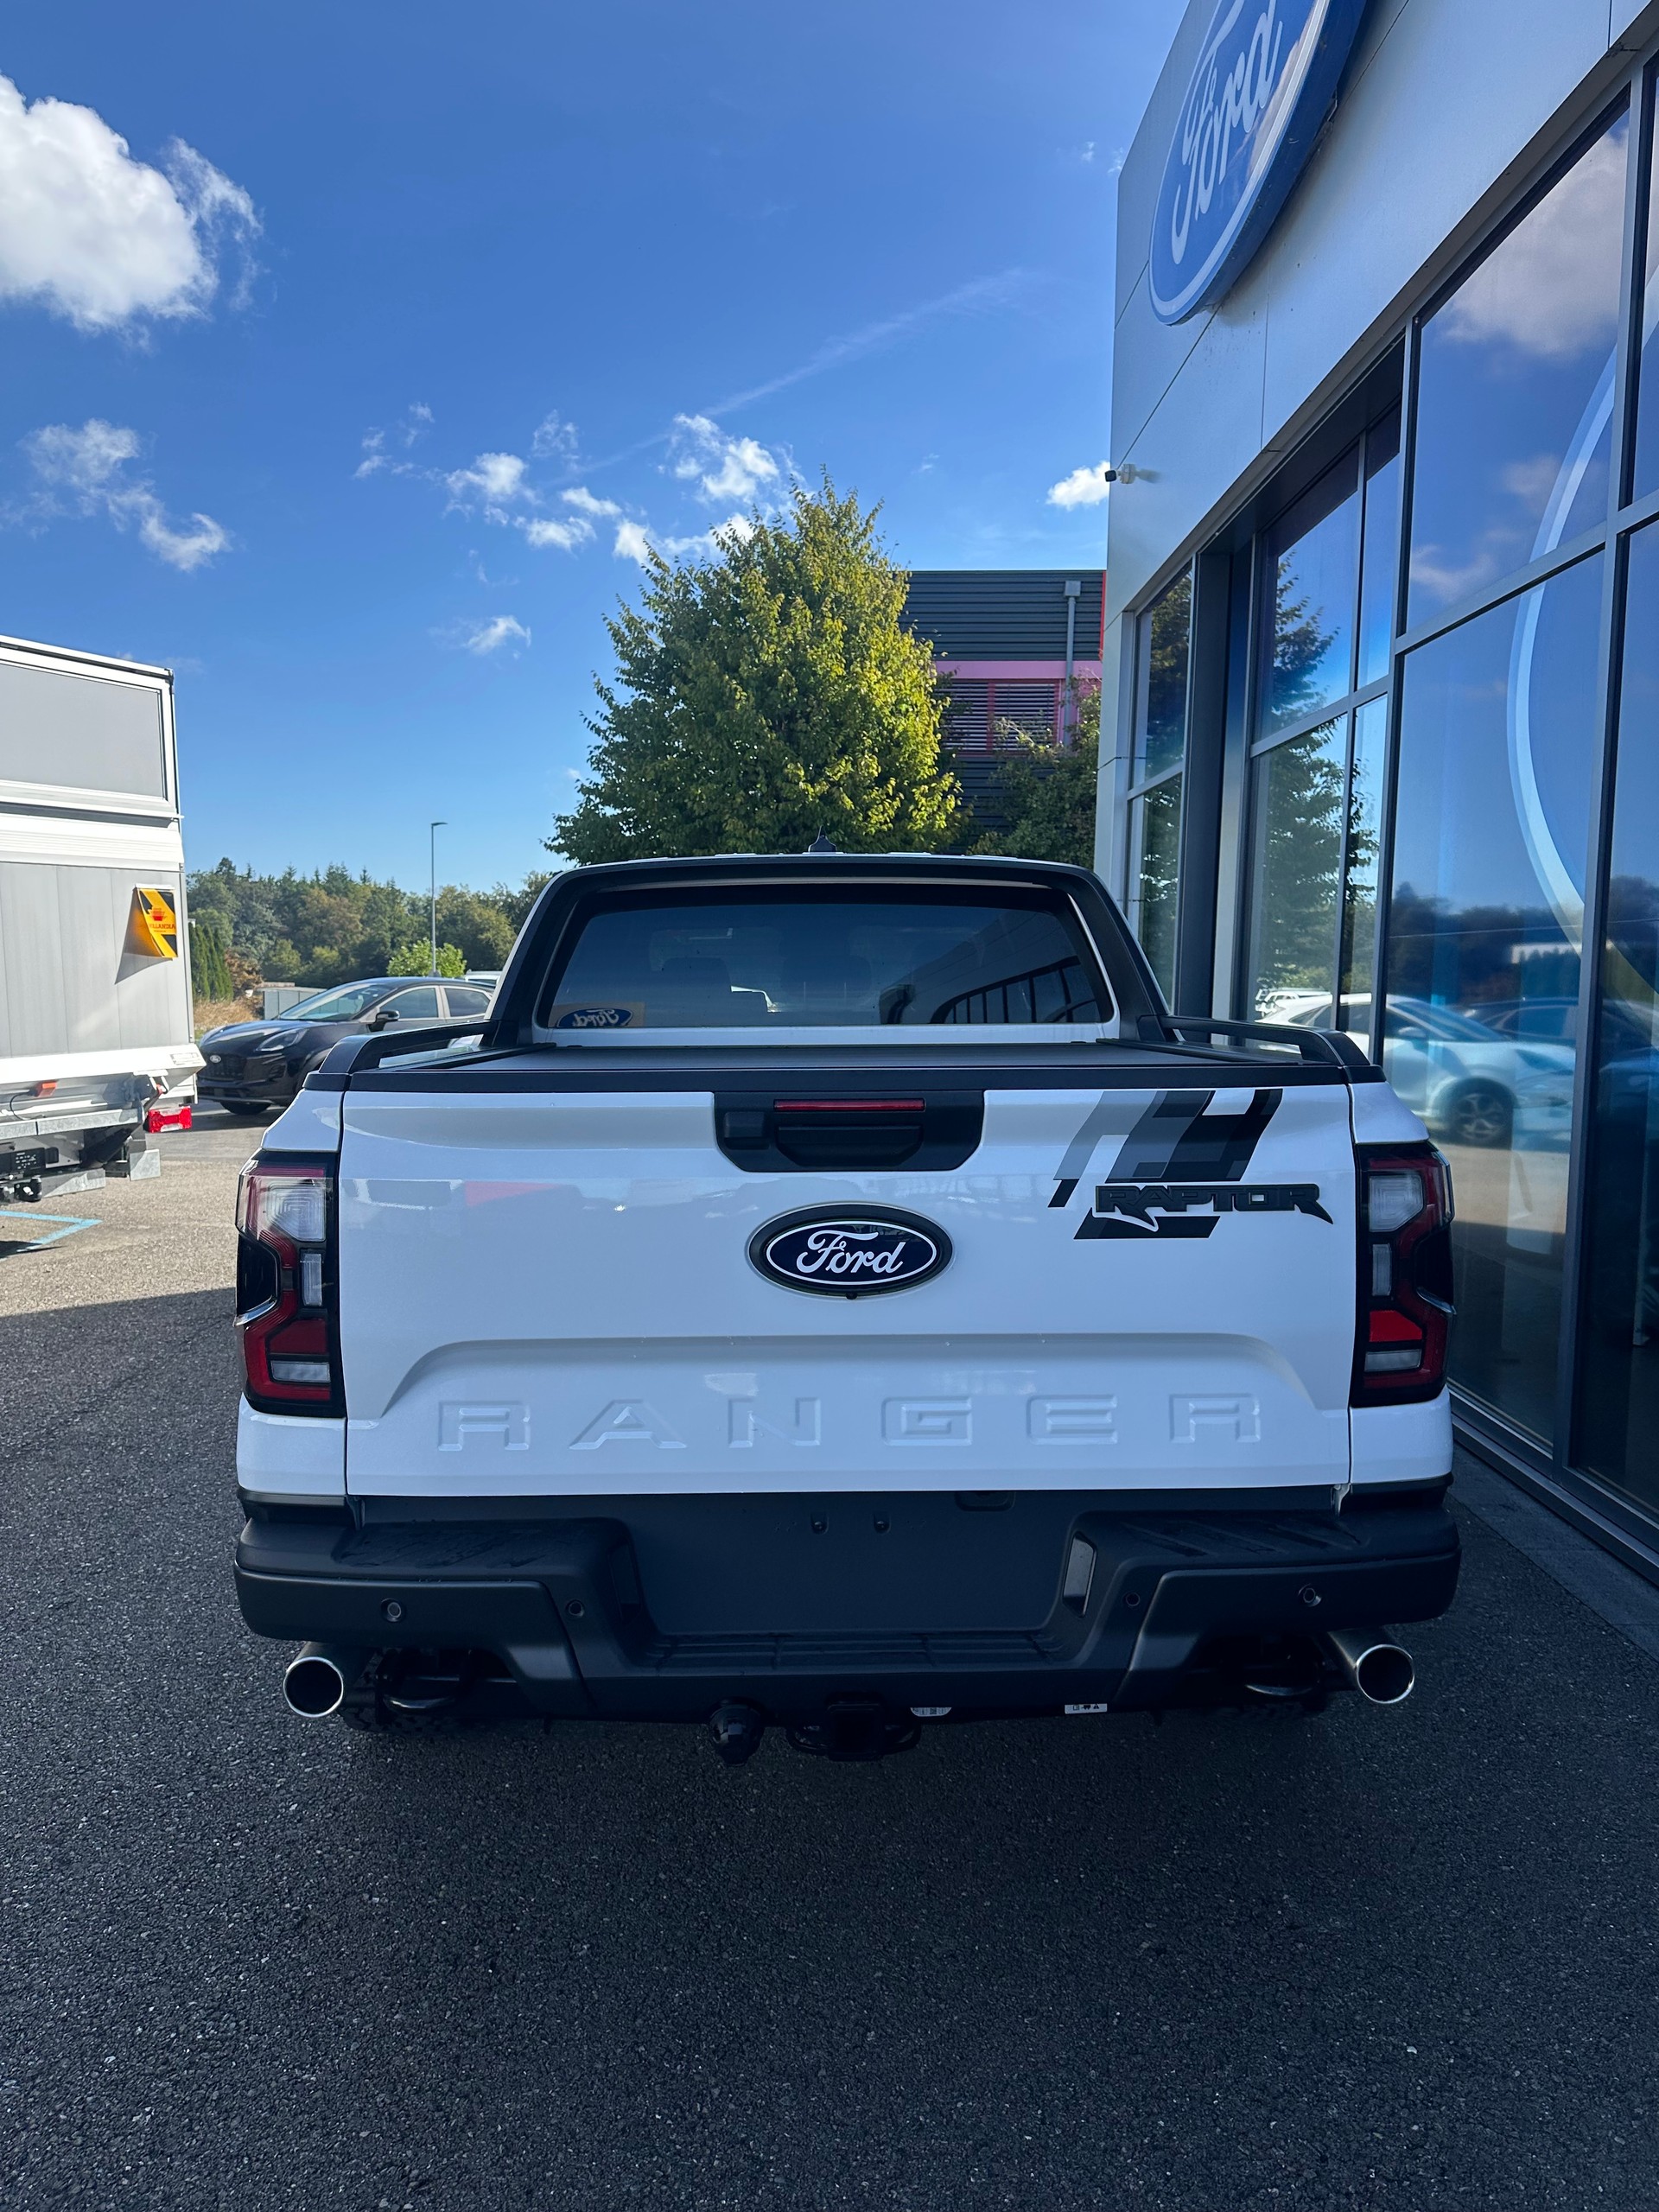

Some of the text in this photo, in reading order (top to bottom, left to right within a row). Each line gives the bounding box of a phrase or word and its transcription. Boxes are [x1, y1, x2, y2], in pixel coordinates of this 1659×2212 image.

[1172, 0, 1283, 264] Ford
[1096, 1184, 1333, 1224] RAPTOR
[796, 1230, 906, 1274] Ford
[437, 1393, 1262, 1452] RANGER
